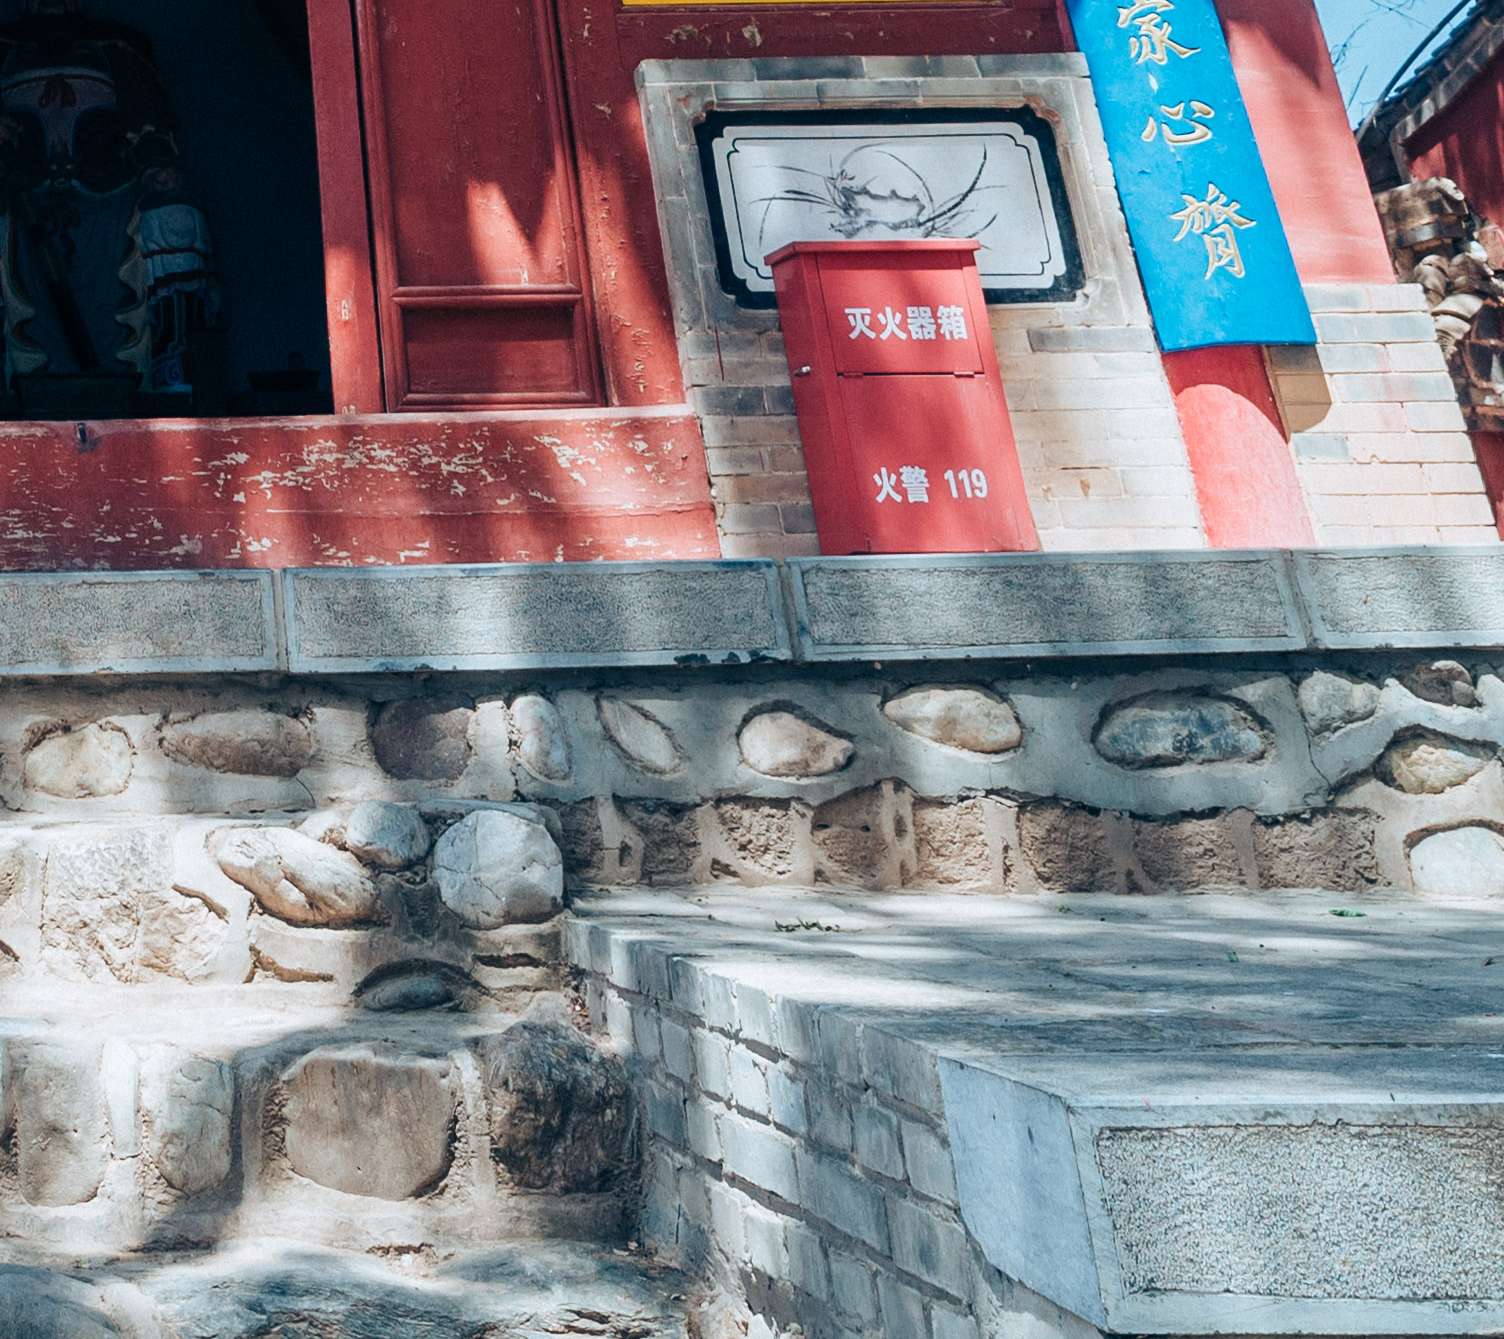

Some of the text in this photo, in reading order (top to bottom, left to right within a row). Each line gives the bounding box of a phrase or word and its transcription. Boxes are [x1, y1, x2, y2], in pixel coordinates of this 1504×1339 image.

[843, 305, 969, 341] 灭火器箱
[873, 465, 988, 504] 火警 119
